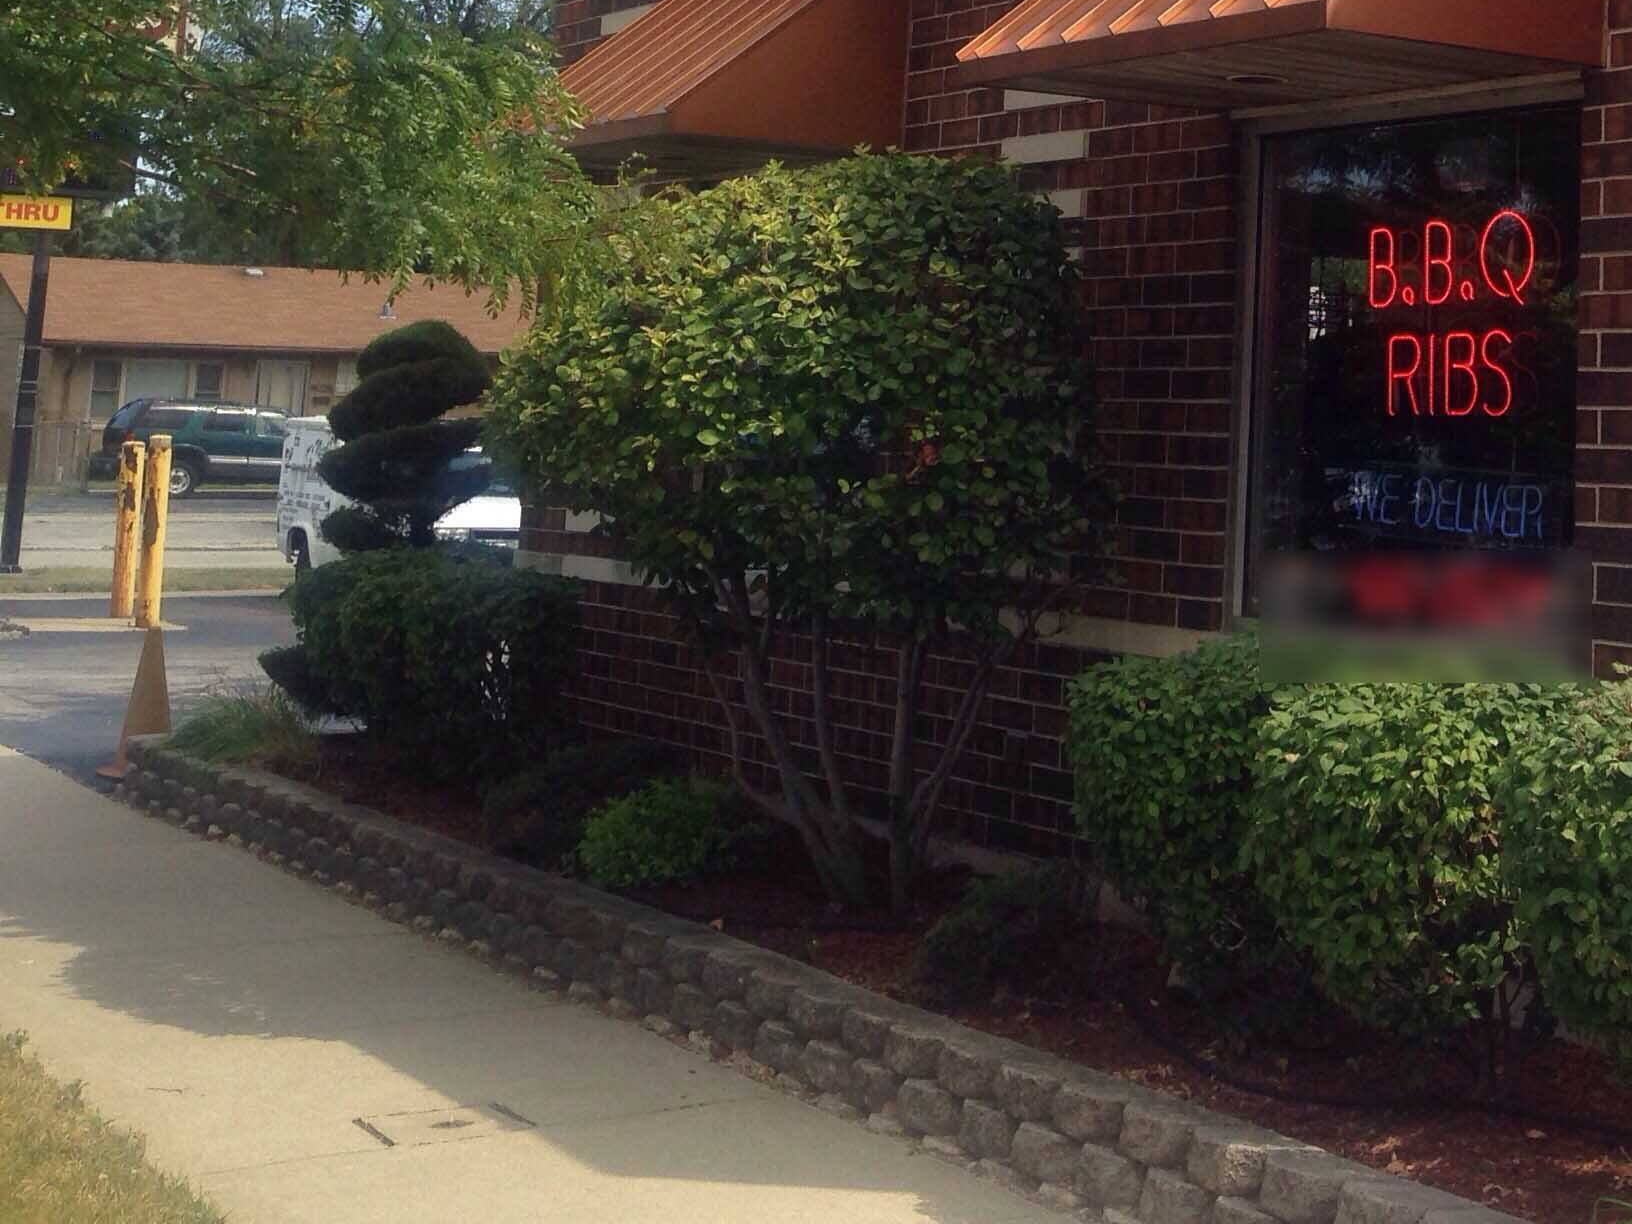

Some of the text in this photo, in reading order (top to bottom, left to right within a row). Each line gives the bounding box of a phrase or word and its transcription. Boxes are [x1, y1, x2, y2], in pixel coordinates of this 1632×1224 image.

[1368, 209, 1535, 309] B.B.Q
[1387, 328, 1514, 417] RIBS
[1353, 471, 1545, 539] WE DELIVER
